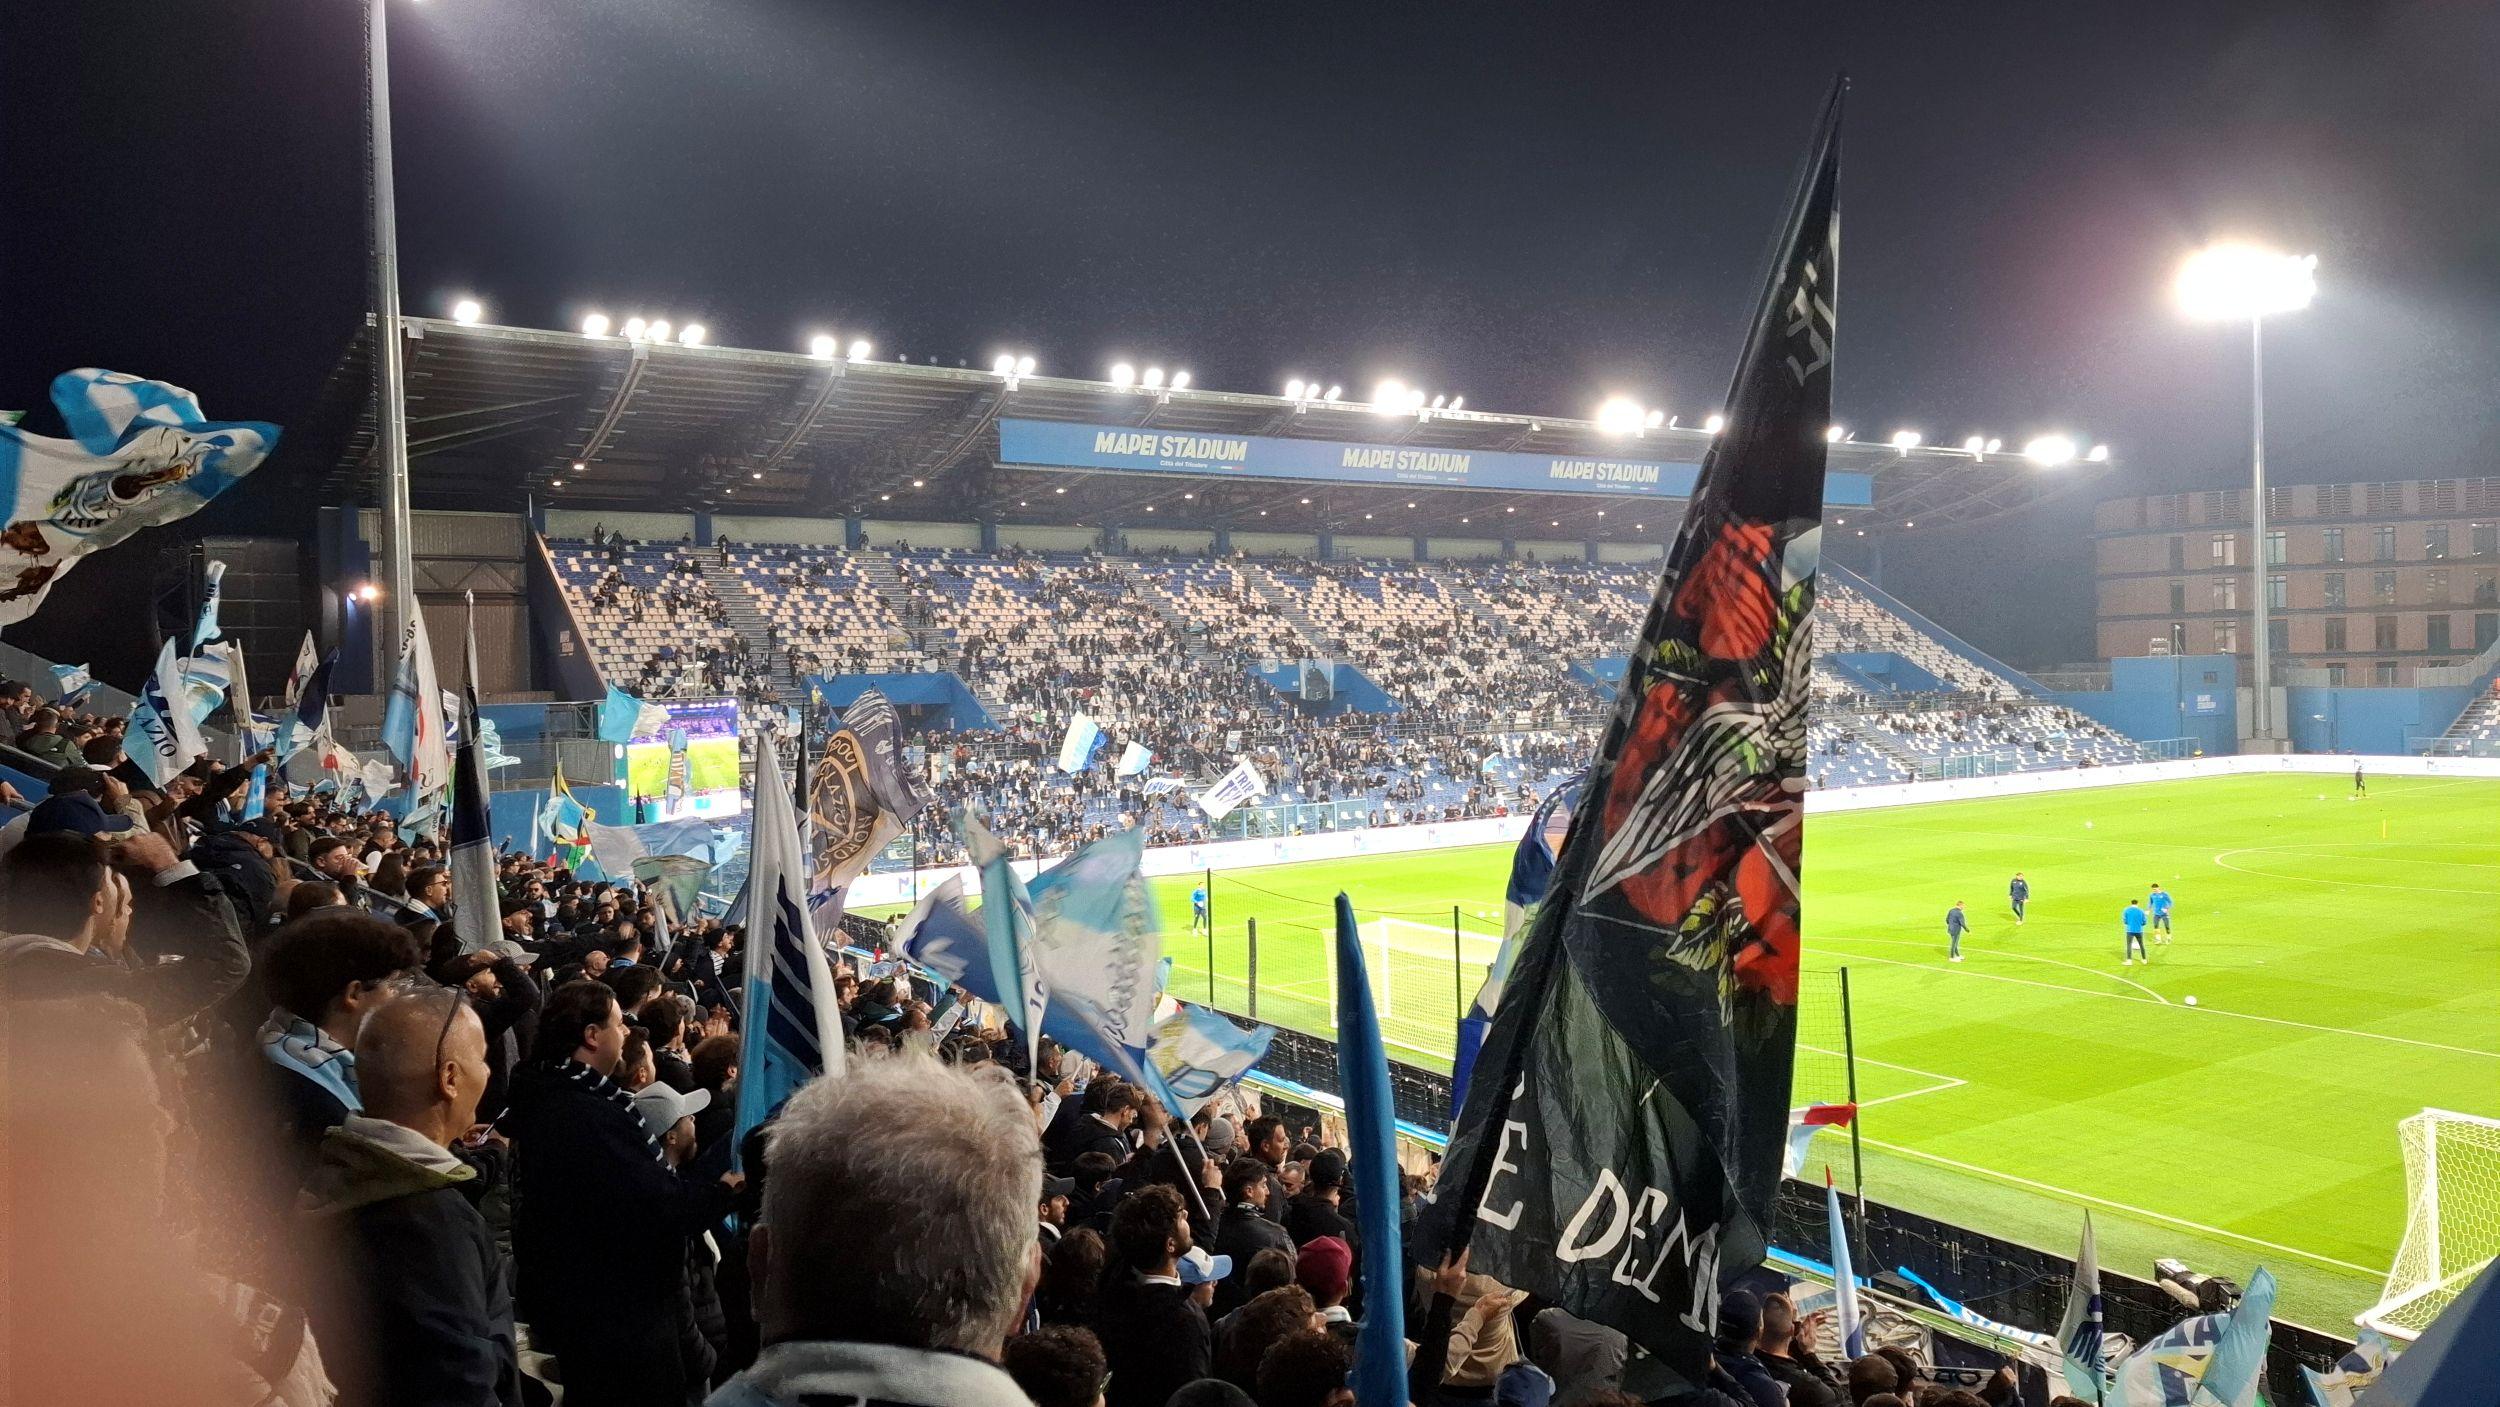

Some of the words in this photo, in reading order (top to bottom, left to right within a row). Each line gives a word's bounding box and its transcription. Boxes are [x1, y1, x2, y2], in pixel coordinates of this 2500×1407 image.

[1094, 431, 1158, 456] MAPEI
[1160, 435, 1248, 461] STADIUM
[1342, 448, 1395, 469] MAPEI
[1397, 451, 1471, 473] STADIUM
[1550, 460, 1595, 480] MAPEI
[1596, 462, 1659, 483] STADIUM
[834, 814, 873, 860] NORD
